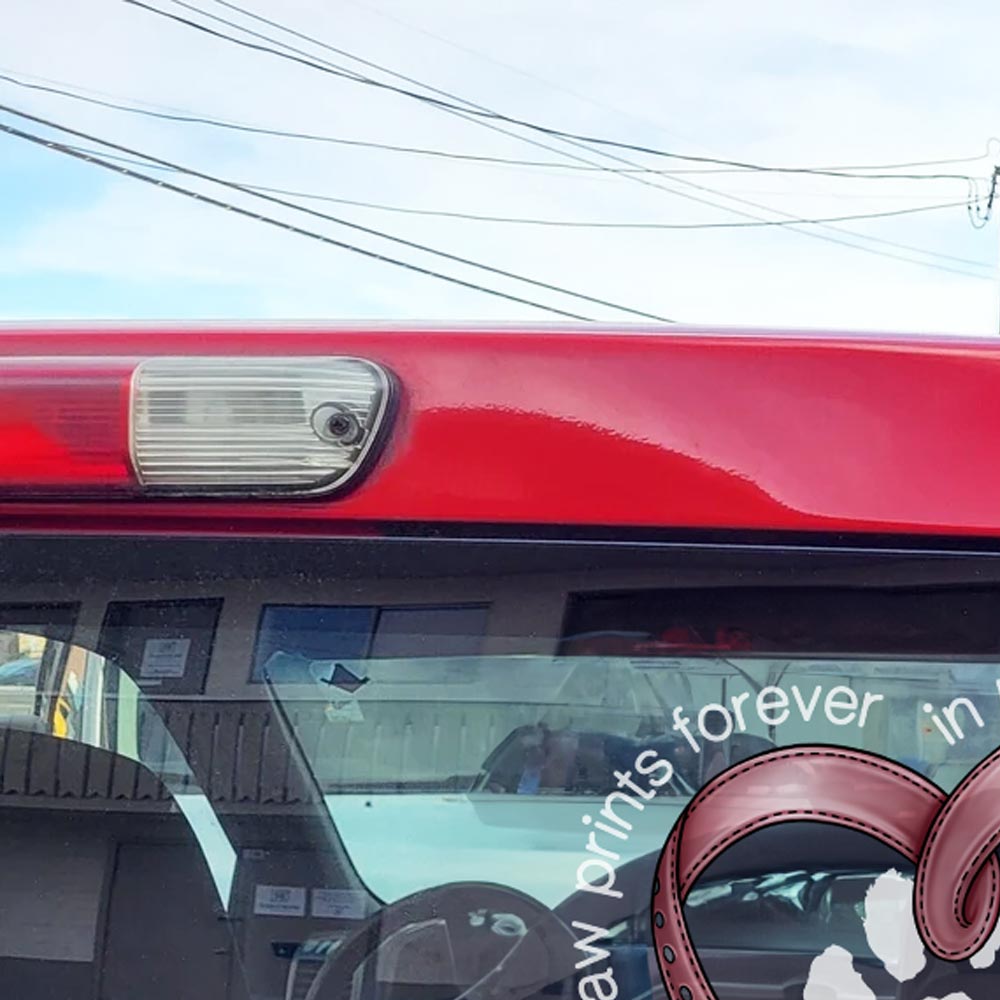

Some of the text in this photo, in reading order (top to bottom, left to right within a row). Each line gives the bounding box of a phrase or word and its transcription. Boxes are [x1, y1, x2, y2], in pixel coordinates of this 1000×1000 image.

[575, 750, 674, 899] prints
[673, 685, 884, 753] forever
[923, 698, 984, 745] in
